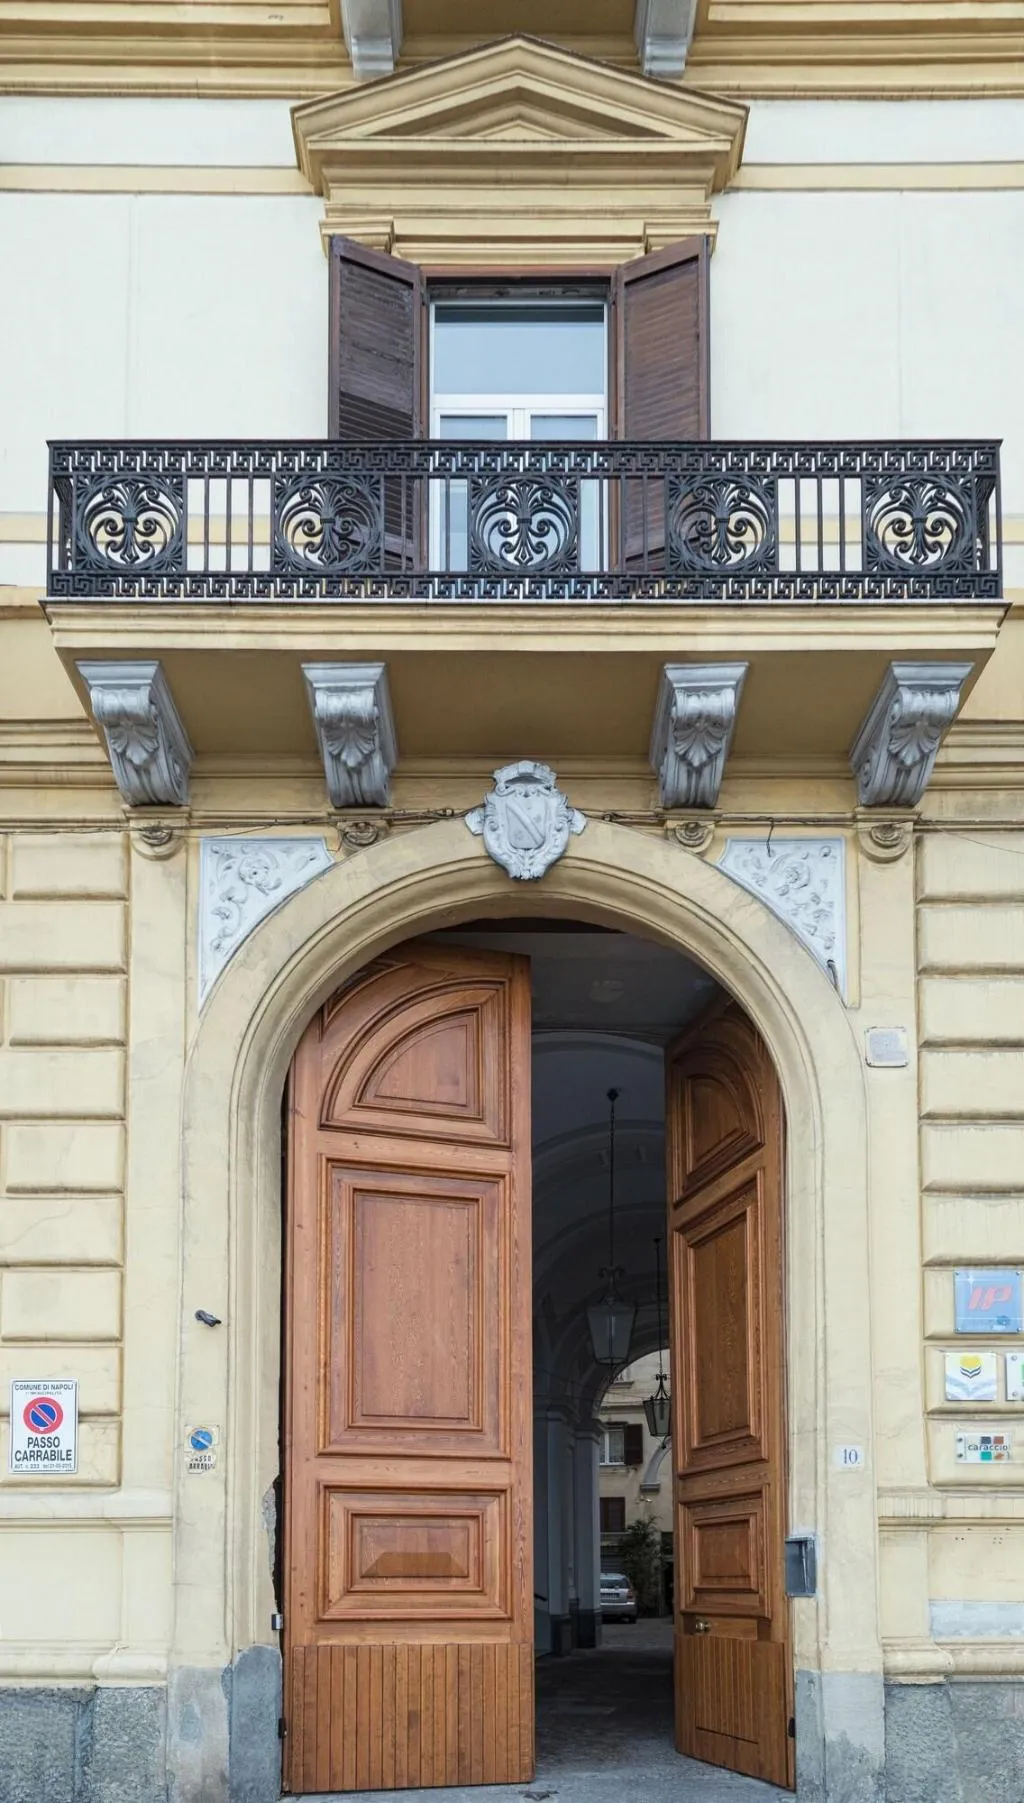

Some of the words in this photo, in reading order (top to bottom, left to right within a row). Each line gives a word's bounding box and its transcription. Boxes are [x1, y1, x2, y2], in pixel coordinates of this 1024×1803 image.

[27, 1436, 60, 1448] PASSO
[14, 1449, 72, 1462] CARRABILE
[844, 1448, 858, 1465] 10
